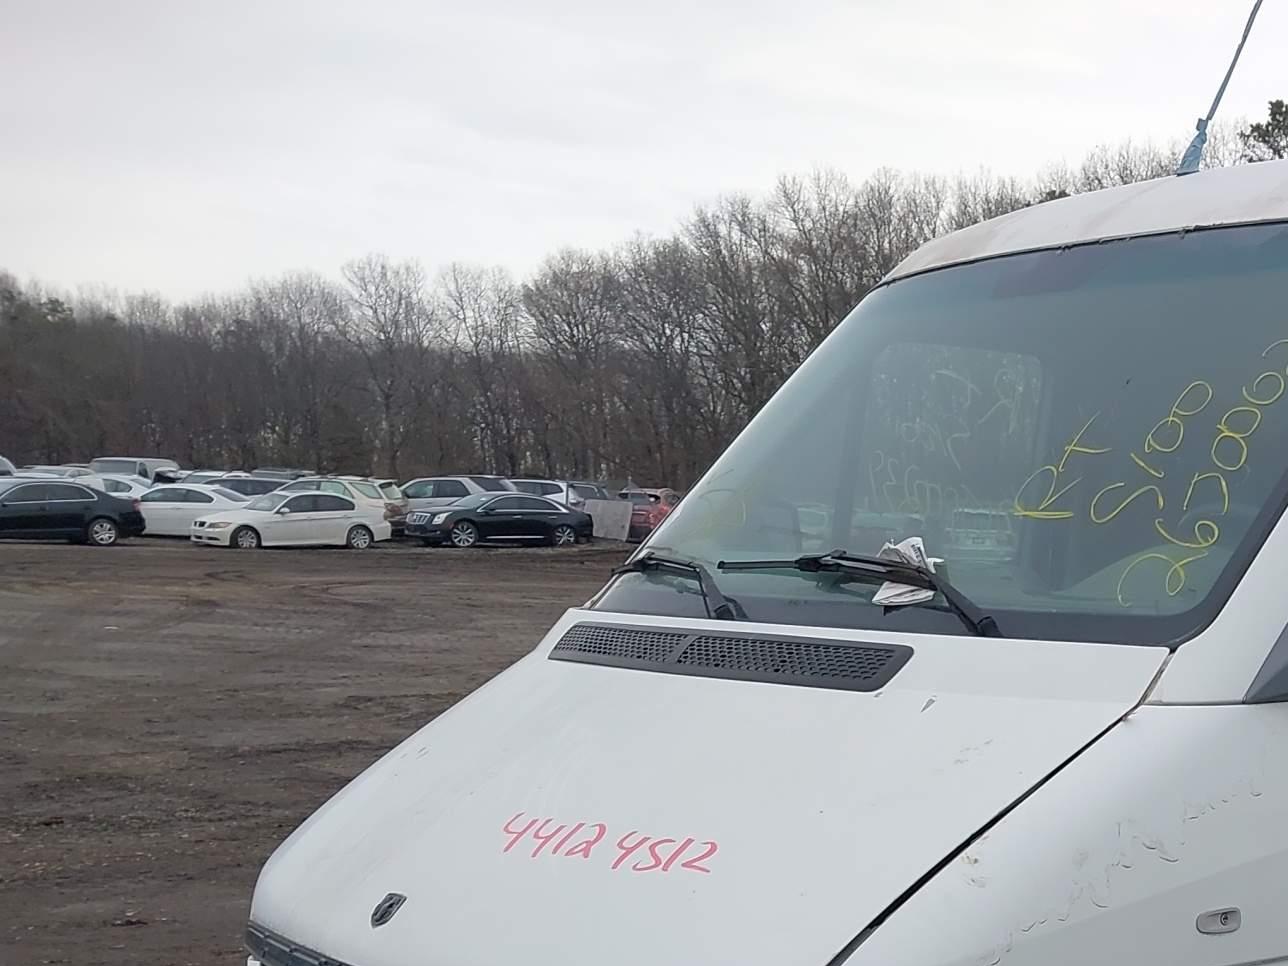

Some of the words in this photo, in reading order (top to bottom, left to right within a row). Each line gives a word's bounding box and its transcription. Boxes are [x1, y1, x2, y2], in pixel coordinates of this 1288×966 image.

[1014, 412, 1111, 518] RT
[1091, 381, 1213, 523] S100
[503, 811, 607, 858] 4412
